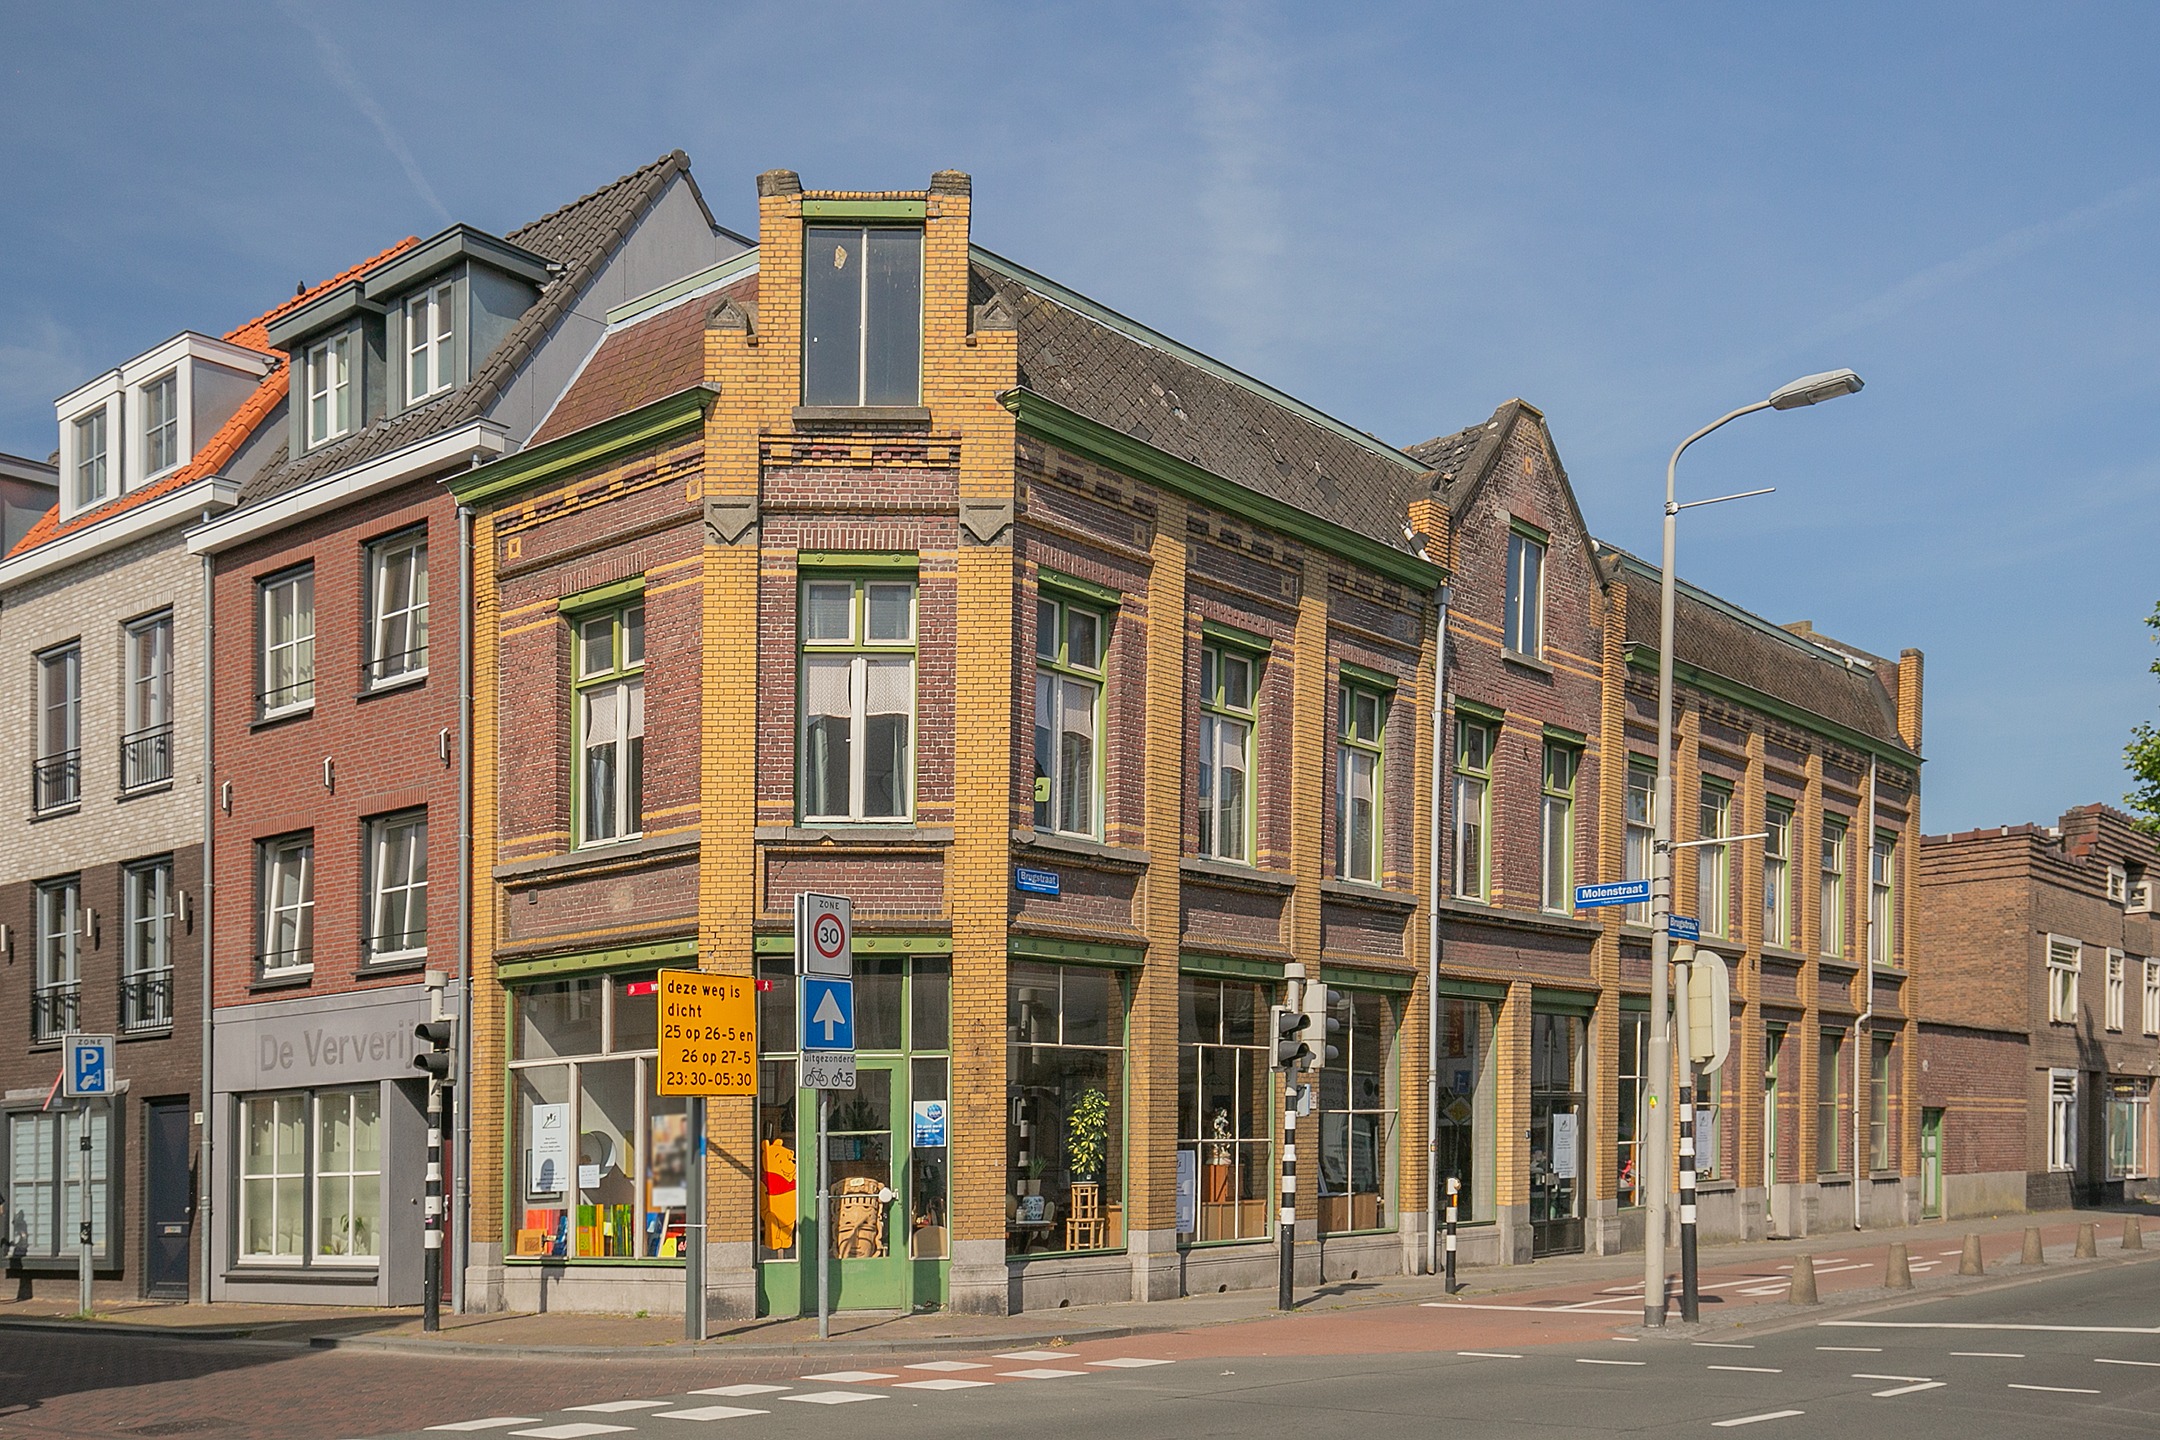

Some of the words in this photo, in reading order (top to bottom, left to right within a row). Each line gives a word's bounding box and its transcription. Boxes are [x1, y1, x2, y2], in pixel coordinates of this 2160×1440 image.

[1020, 871, 1056, 885] Brugstraat
[1582, 884, 1643, 899] Molenstraat
[819, 900, 840, 910] ZONE
[820, 927, 839, 944] 30
[667, 980, 697, 995] deze
[702, 985, 725, 1001] weg
[730, 985, 741, 998] is
[667, 1003, 702, 1018] dicht
[665, 1024, 681, 1039] 25
[686, 1029, 701, 1042] op
[705, 1027, 736, 1041] 26-5
[739, 1031, 753, 1042] en
[260, 1034, 294, 1071] De
[303, 1019, 414, 1070] Ververij
[81, 1049, 99, 1073] P
[681, 1049, 698, 1063] 26
[702, 1053, 717, 1066] op
[721, 1050, 751, 1064] 27-5
[804, 1054, 855, 1065] uitgezonderd
